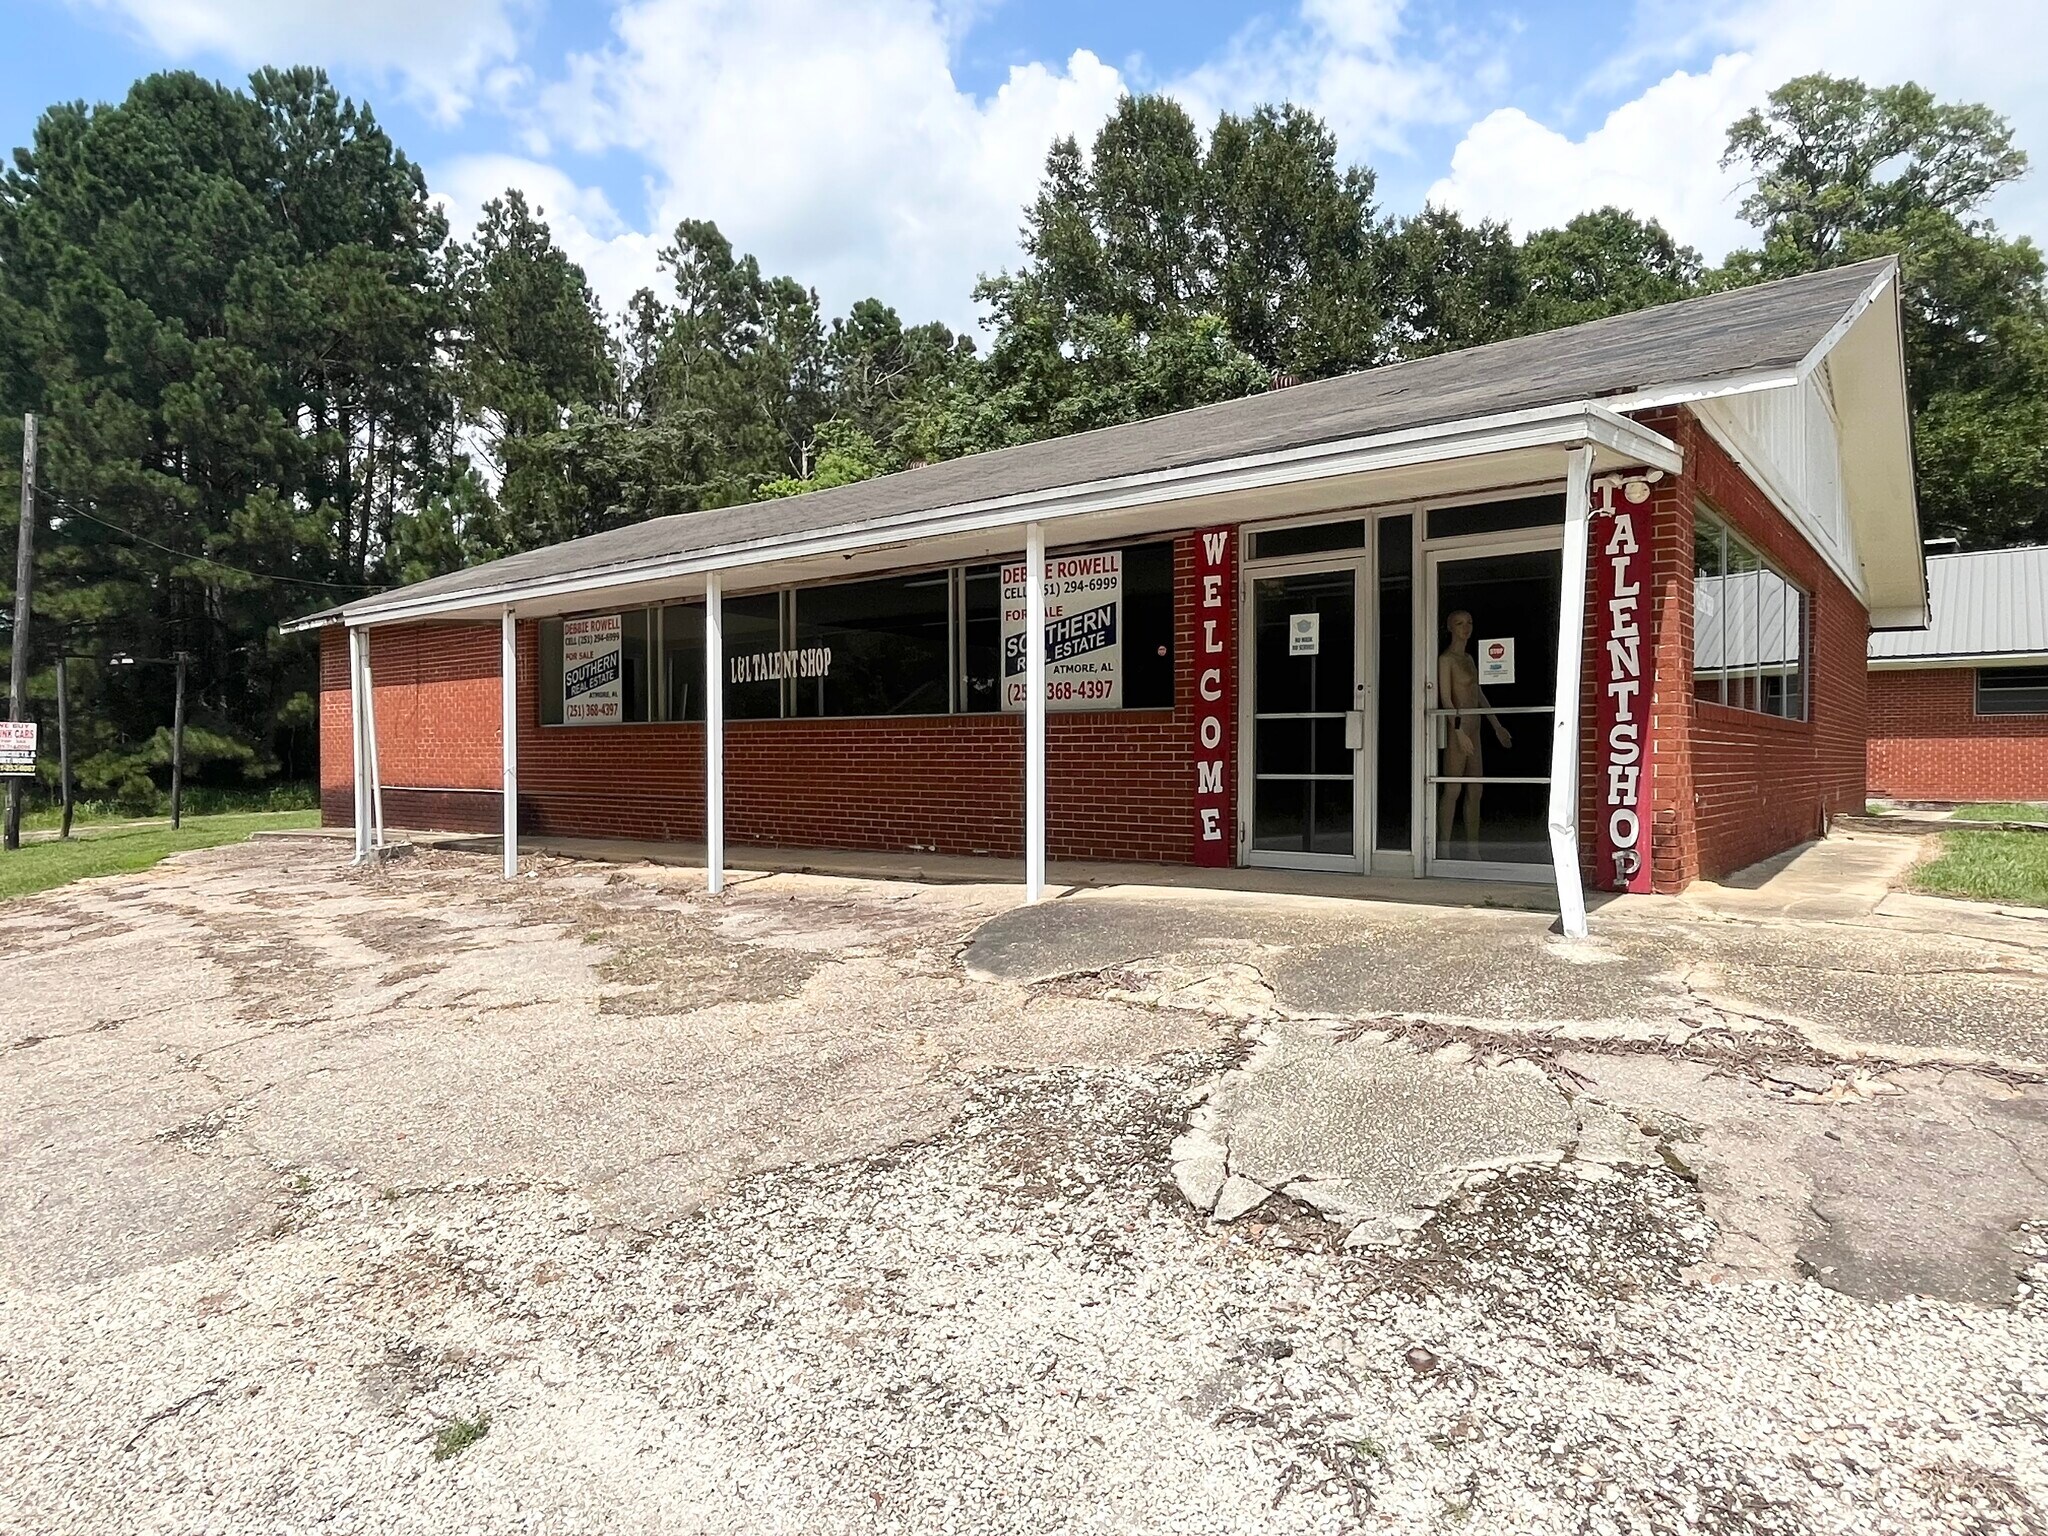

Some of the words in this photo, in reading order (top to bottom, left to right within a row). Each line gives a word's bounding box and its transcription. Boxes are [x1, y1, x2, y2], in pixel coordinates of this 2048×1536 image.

[1002, 563, 1054, 585] DEBE
[1057, 556, 1119, 579] ROWELL
[1063, 576, 1118, 594] 294-6999
[565, 621, 589, 635] DEBBIE
[590, 617, 620, 633] ROWELL
[1007, 606, 1111, 658] SOTHERN
[579, 651, 594, 660] SALE
[1054, 631, 1106, 660] ESTATE
[566, 652, 617, 687] SOUTHERN
[752, 650, 799, 682] TALENT
[800, 647, 832, 678] SHOP
[1053, 663, 1097, 675] ATMORE,
[1101, 662, 1114, 672] AL
[571, 681, 588, 697] REAL
[589, 669, 615, 689] ESTATE
[1046, 680, 1113, 700] 368-4397
[1197, 532, 1227, 840] WELCOME
[567, 704, 584, 720] (251)
[586, 703, 618, 717] 368-4397
